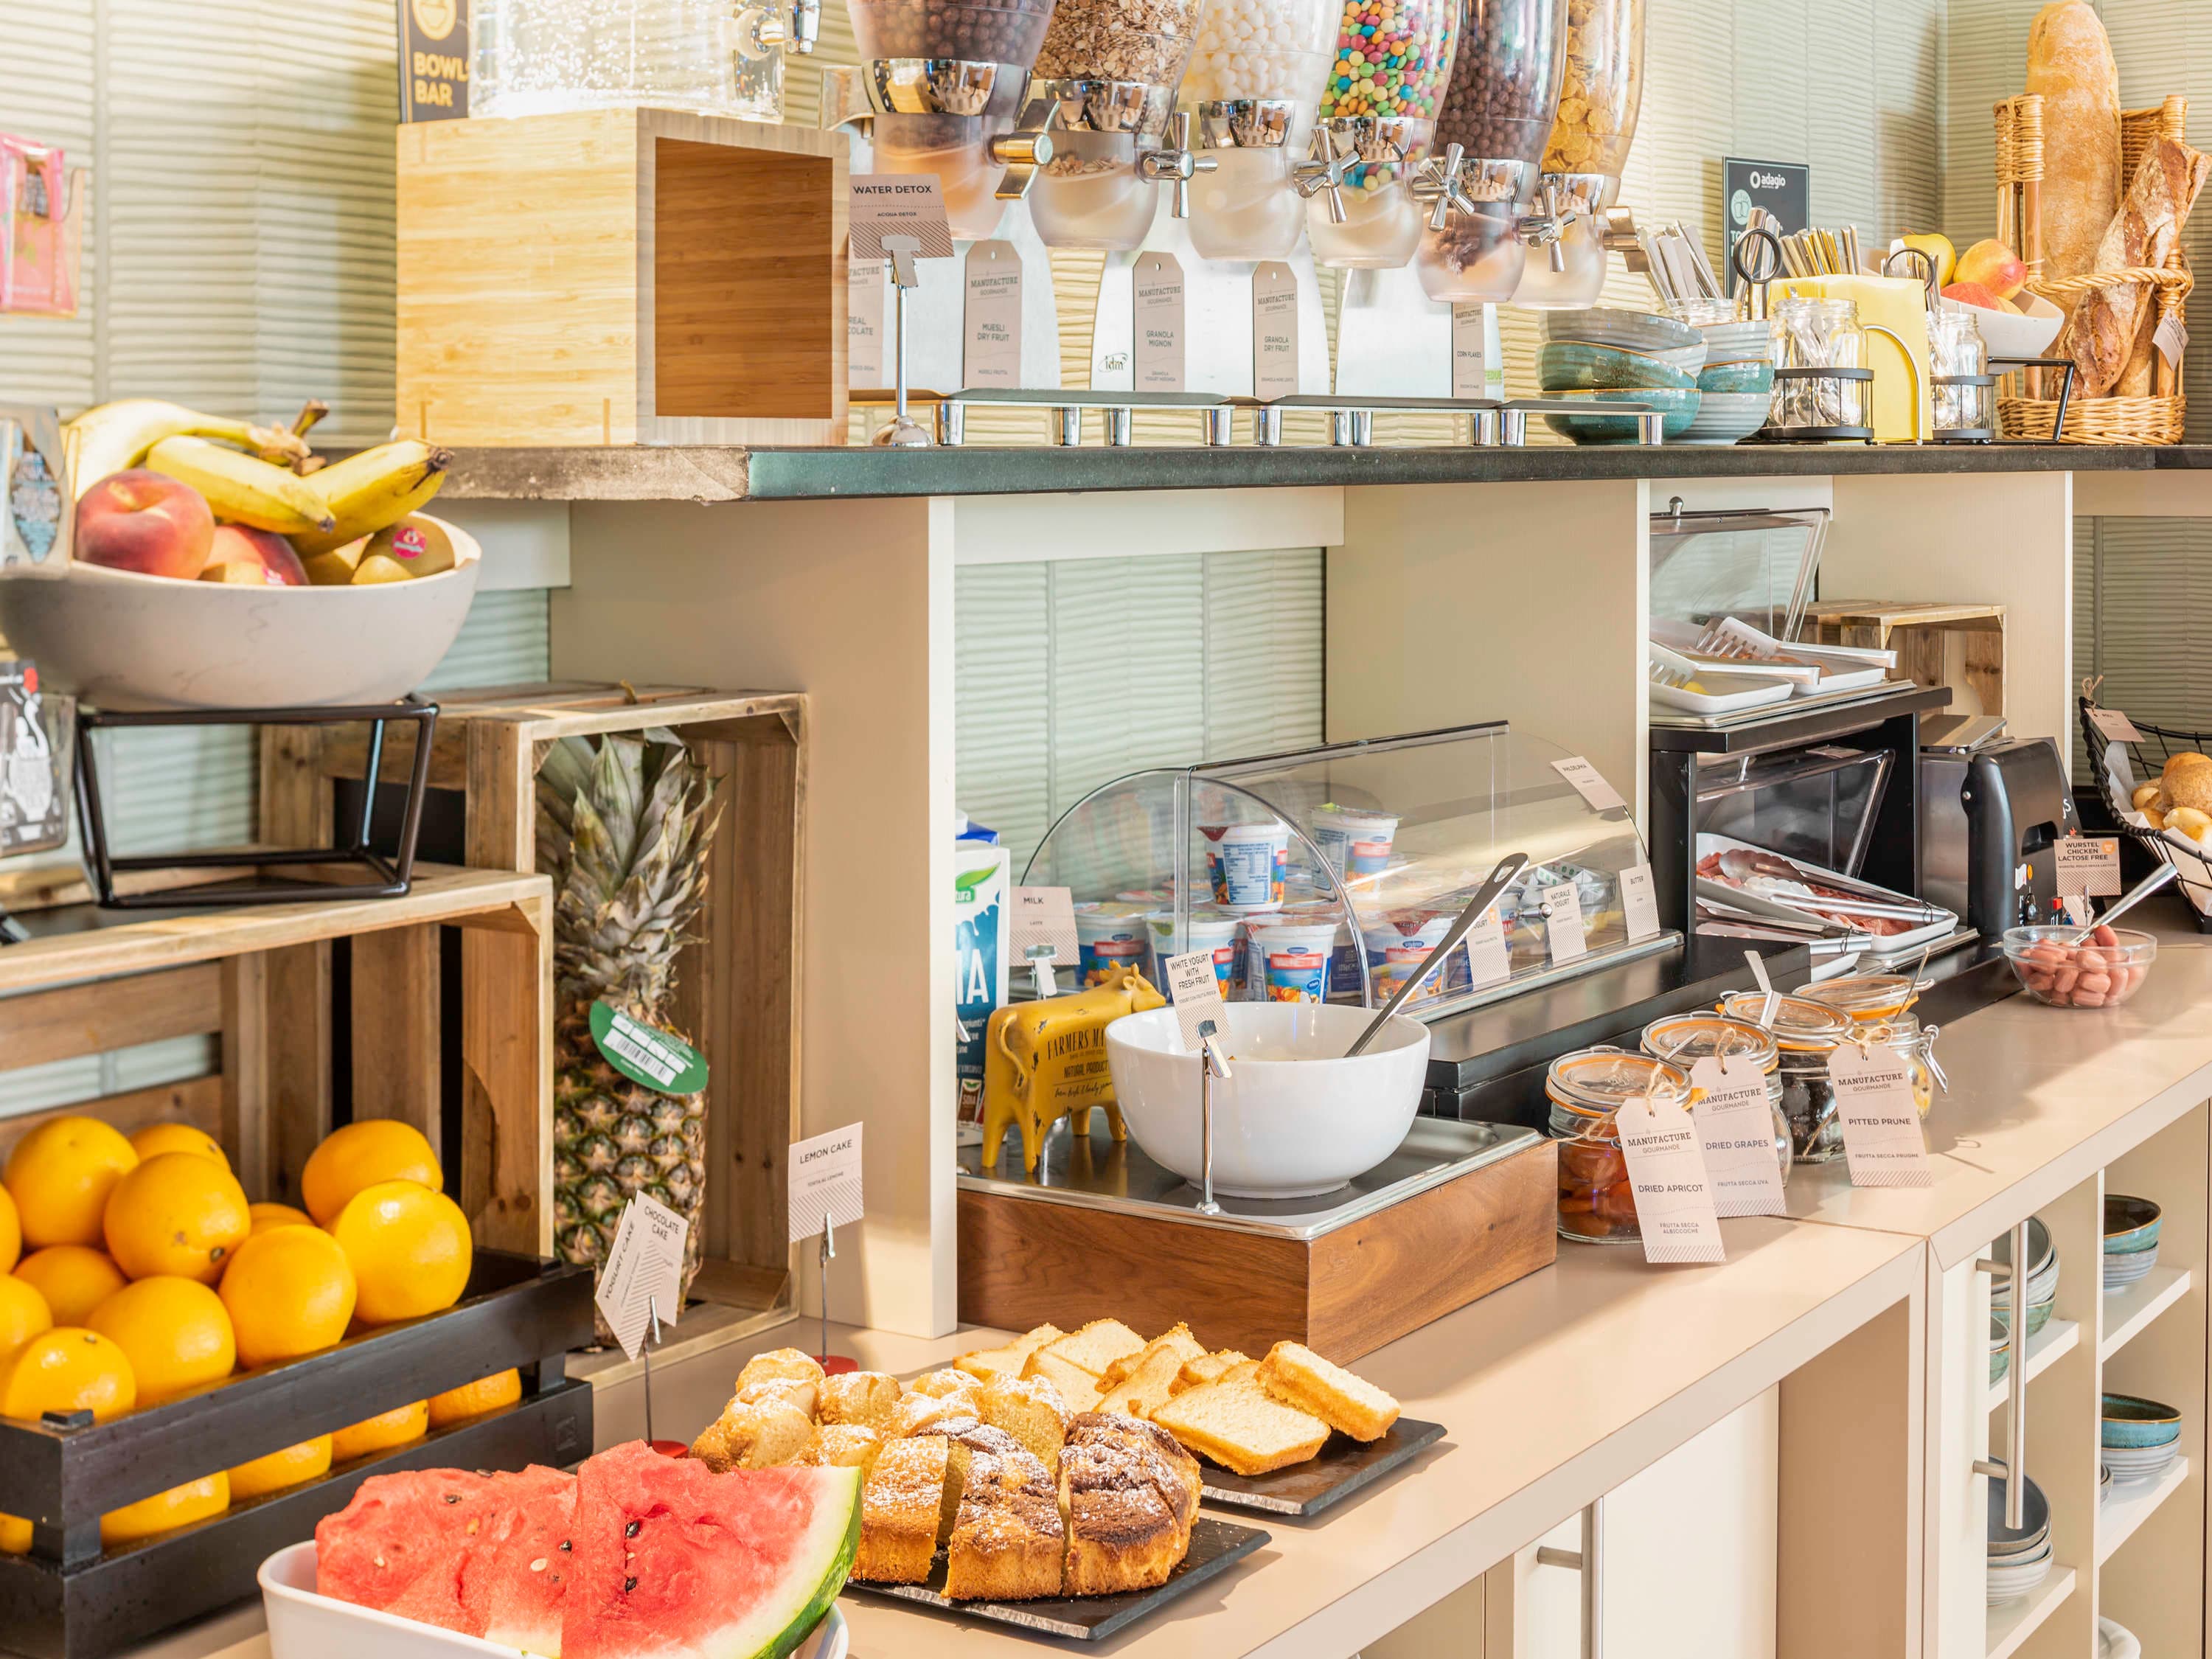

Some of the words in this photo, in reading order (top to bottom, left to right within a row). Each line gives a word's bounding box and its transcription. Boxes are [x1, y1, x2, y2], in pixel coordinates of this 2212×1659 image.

[414, 79, 453, 107] BAR
[1761, 173, 1786, 189] adagio
[852, 185, 892, 194] WATER
[895, 185, 932, 194] DETOX
[970, 276, 1018, 288] MANUFACTURE
[1138, 285, 1181, 298] MANUFACTURE
[1257, 293, 1295, 305] MANUFACTURE
[982, 322, 1006, 332] MUESLI
[977, 332, 990, 341] DRY
[991, 333, 1009, 342] FRUIT
[1146, 330, 1175, 338] GRANOLA
[1264, 335, 1289, 344] GRANOLA
[1149, 339, 1172, 348] MIGNON
[1263, 344, 1274, 352] DRY
[1630, 875, 1644, 886] BUTTER
[1551, 889, 1571, 900] NATURALE
[1023, 897, 1044, 905] MILK
[1554, 898, 1570, 908] YOGURT
[1170, 959, 1189, 971] WHITE
[1188, 953, 1209, 966] YOGURT
[1185, 967, 1200, 977] WITH
[1178, 978, 1195, 990] FRESH
[1195, 974, 1210, 986] FRUIT
[1047, 1029, 1089, 1060] FARMERS
[1064, 1063, 1085, 1079] NATURAL
[1837, 1073, 1903, 1086] MANUFACTURE
[1853, 1083, 1891, 1092] GOURMANDE
[1697, 1088, 1761, 1105] MANUFACTURE
[1711, 1100, 1750, 1112] GOURMANDE
[1627, 1132, 1691, 1147] MANUFACTURE
[1705, 1142, 1732, 1150] DRIED
[1733, 1139, 1769, 1148] GRAPES
[799, 1147, 829, 1164] LEMON
[830, 1139, 852, 1154] CAKE
[1642, 1144, 1680, 1154] GOURMANDE
[1666, 1184, 1704, 1192] APRICOT
[644, 1206, 679, 1234] CHOCOLATE
[652, 1224, 668, 1241] CAKE
[605, 1253, 623, 1300] YOGURT
[623, 1221, 635, 1252] CAKE
